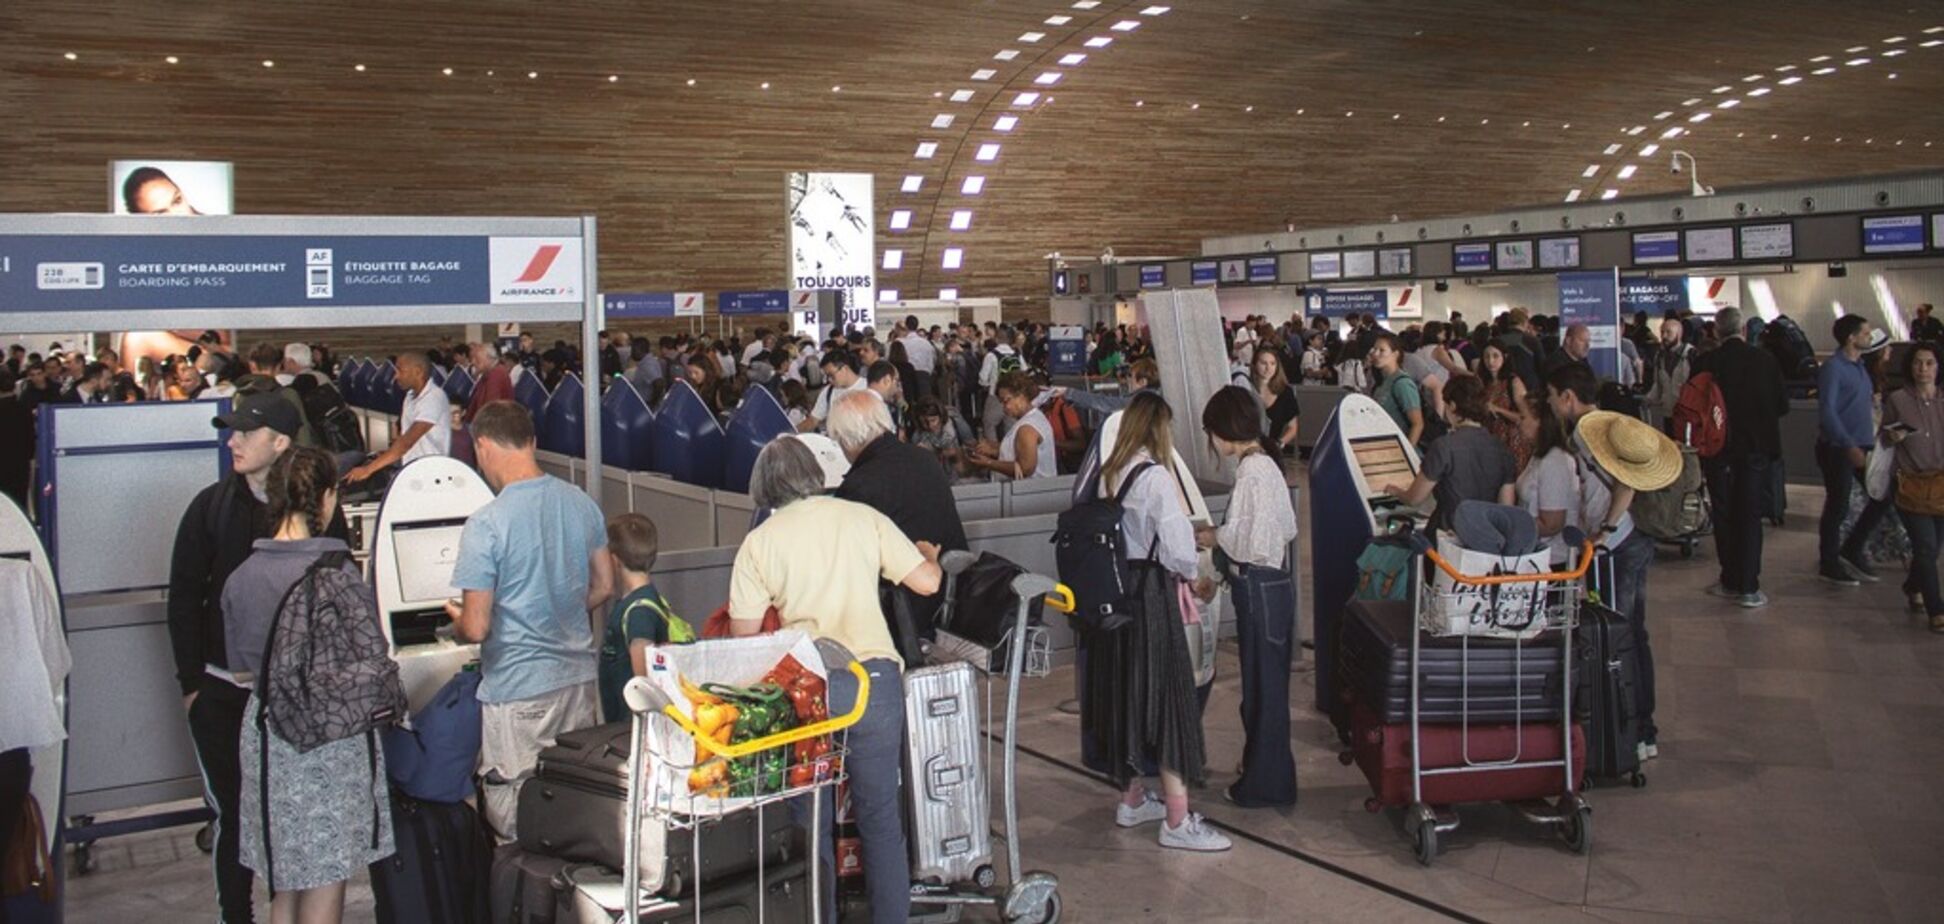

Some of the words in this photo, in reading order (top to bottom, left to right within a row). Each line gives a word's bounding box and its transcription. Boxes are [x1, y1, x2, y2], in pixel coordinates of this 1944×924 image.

[312, 252, 328, 260] AF
[119, 263, 162, 273] CARTE
[166, 263, 287, 273] D'EMBARQUEMENT
[345, 260, 407, 271] ÉTIQUETTE
[410, 261, 460, 270] BAGAGE
[119, 277, 190, 287] BOARDING
[194, 277, 226, 286] PASS
[345, 274, 403, 284] BAGGAGE
[408, 274, 431, 283] TAG
[796, 276, 871, 288] TOUJOURS
[311, 287, 329, 295] JFK
[500, 287, 556, 296] AIRFRANCE
